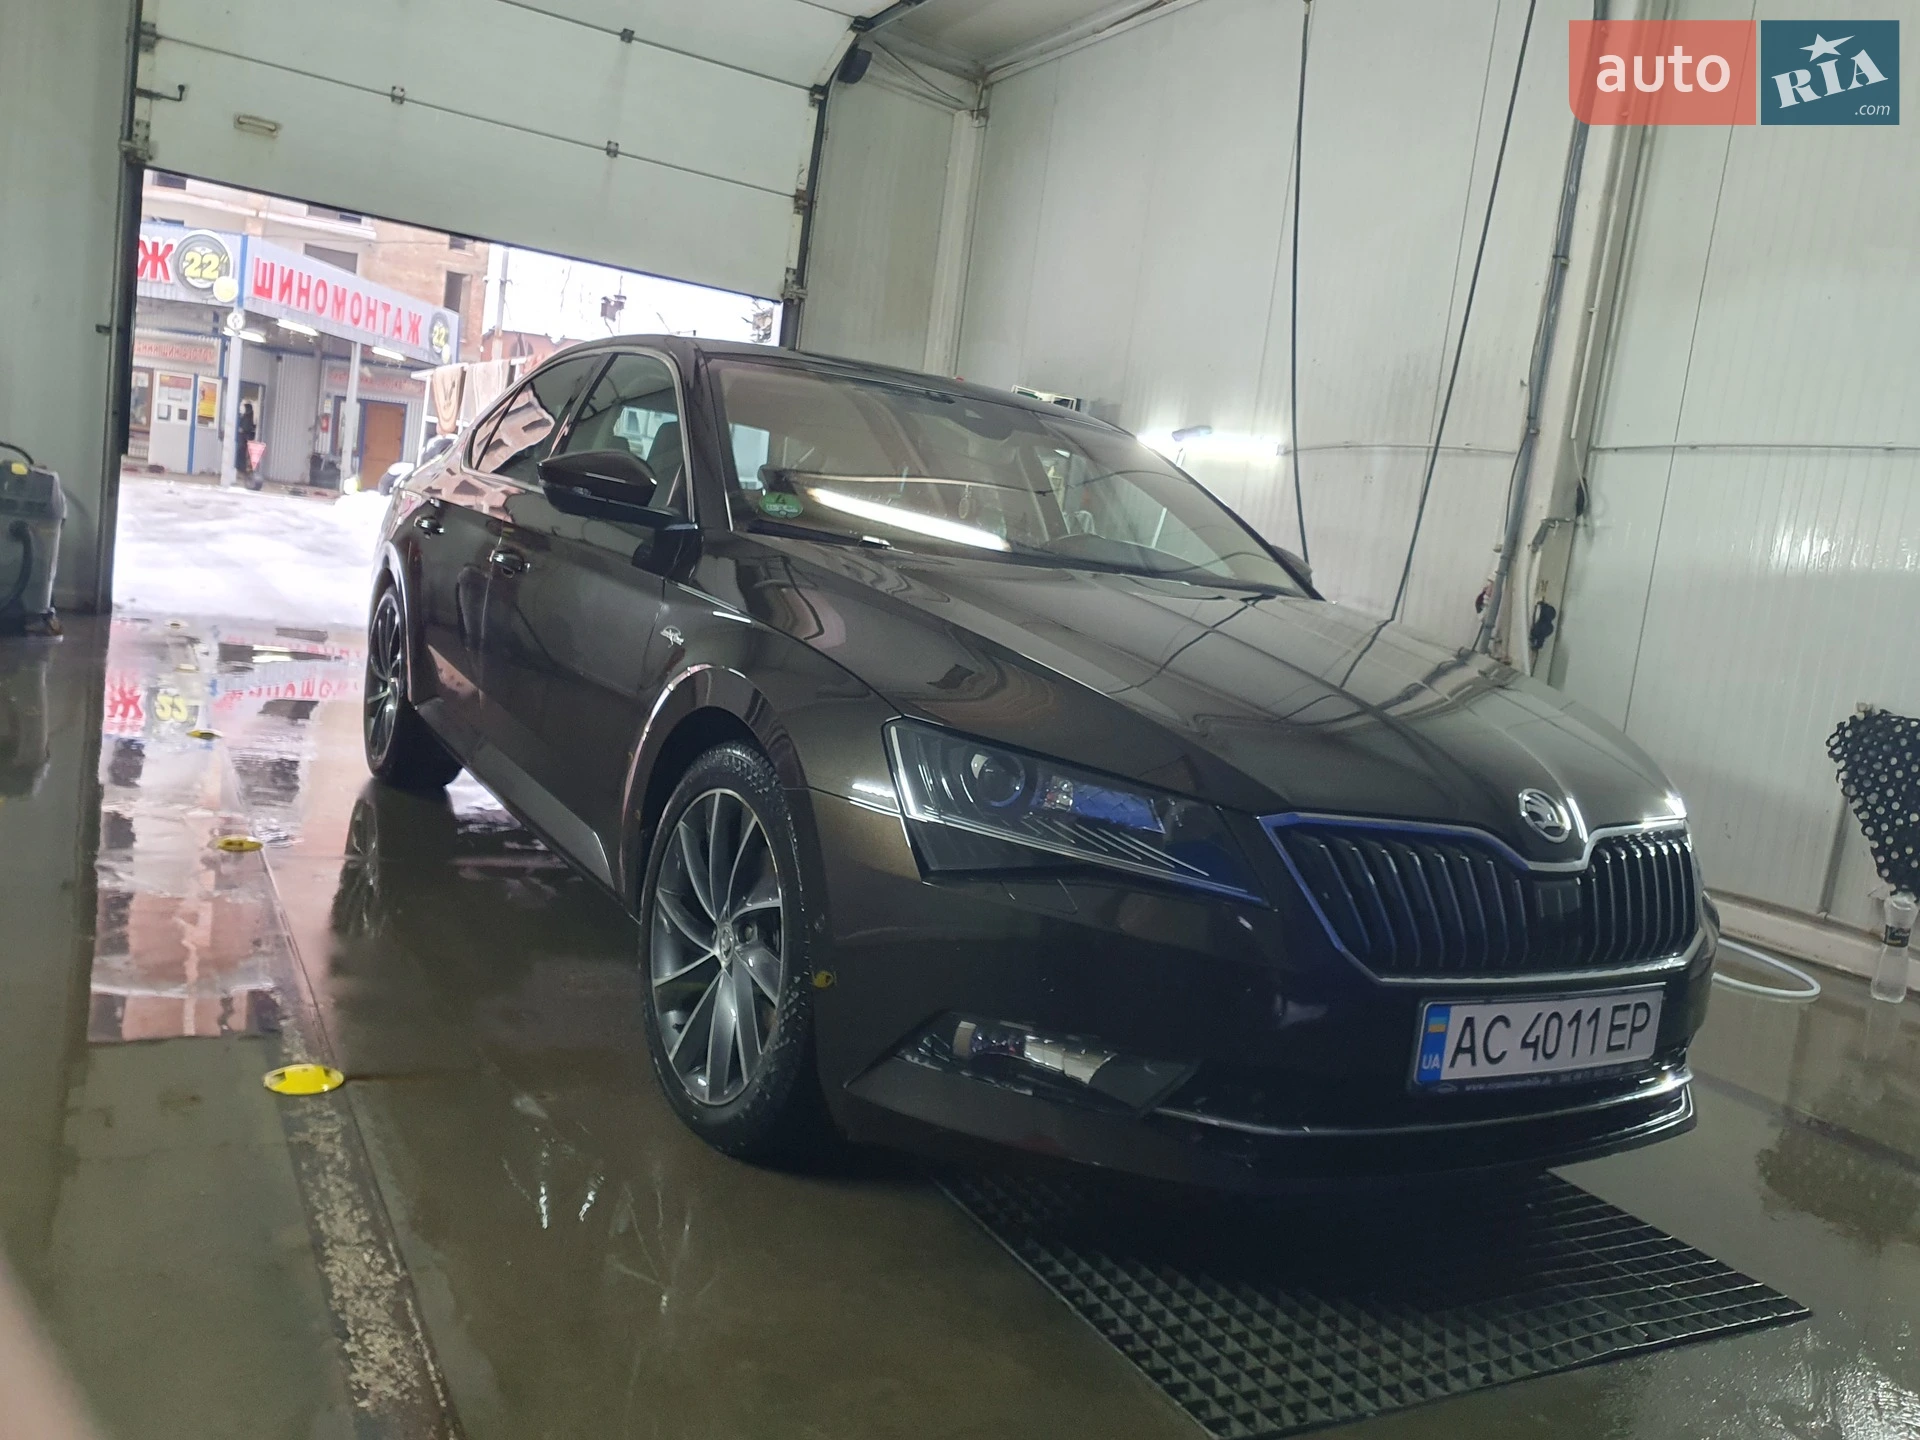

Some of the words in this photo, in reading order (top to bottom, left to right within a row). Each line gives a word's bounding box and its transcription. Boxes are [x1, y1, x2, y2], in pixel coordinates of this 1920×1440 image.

[252, 256, 423, 345] ШИНОМОНТАЖ
[1422, 1053, 1441, 1070] UA
[1448, 1014, 1512, 1069] AC
[1519, 1006, 1602, 1062] 4011
[1605, 1001, 1651, 1051] EP
